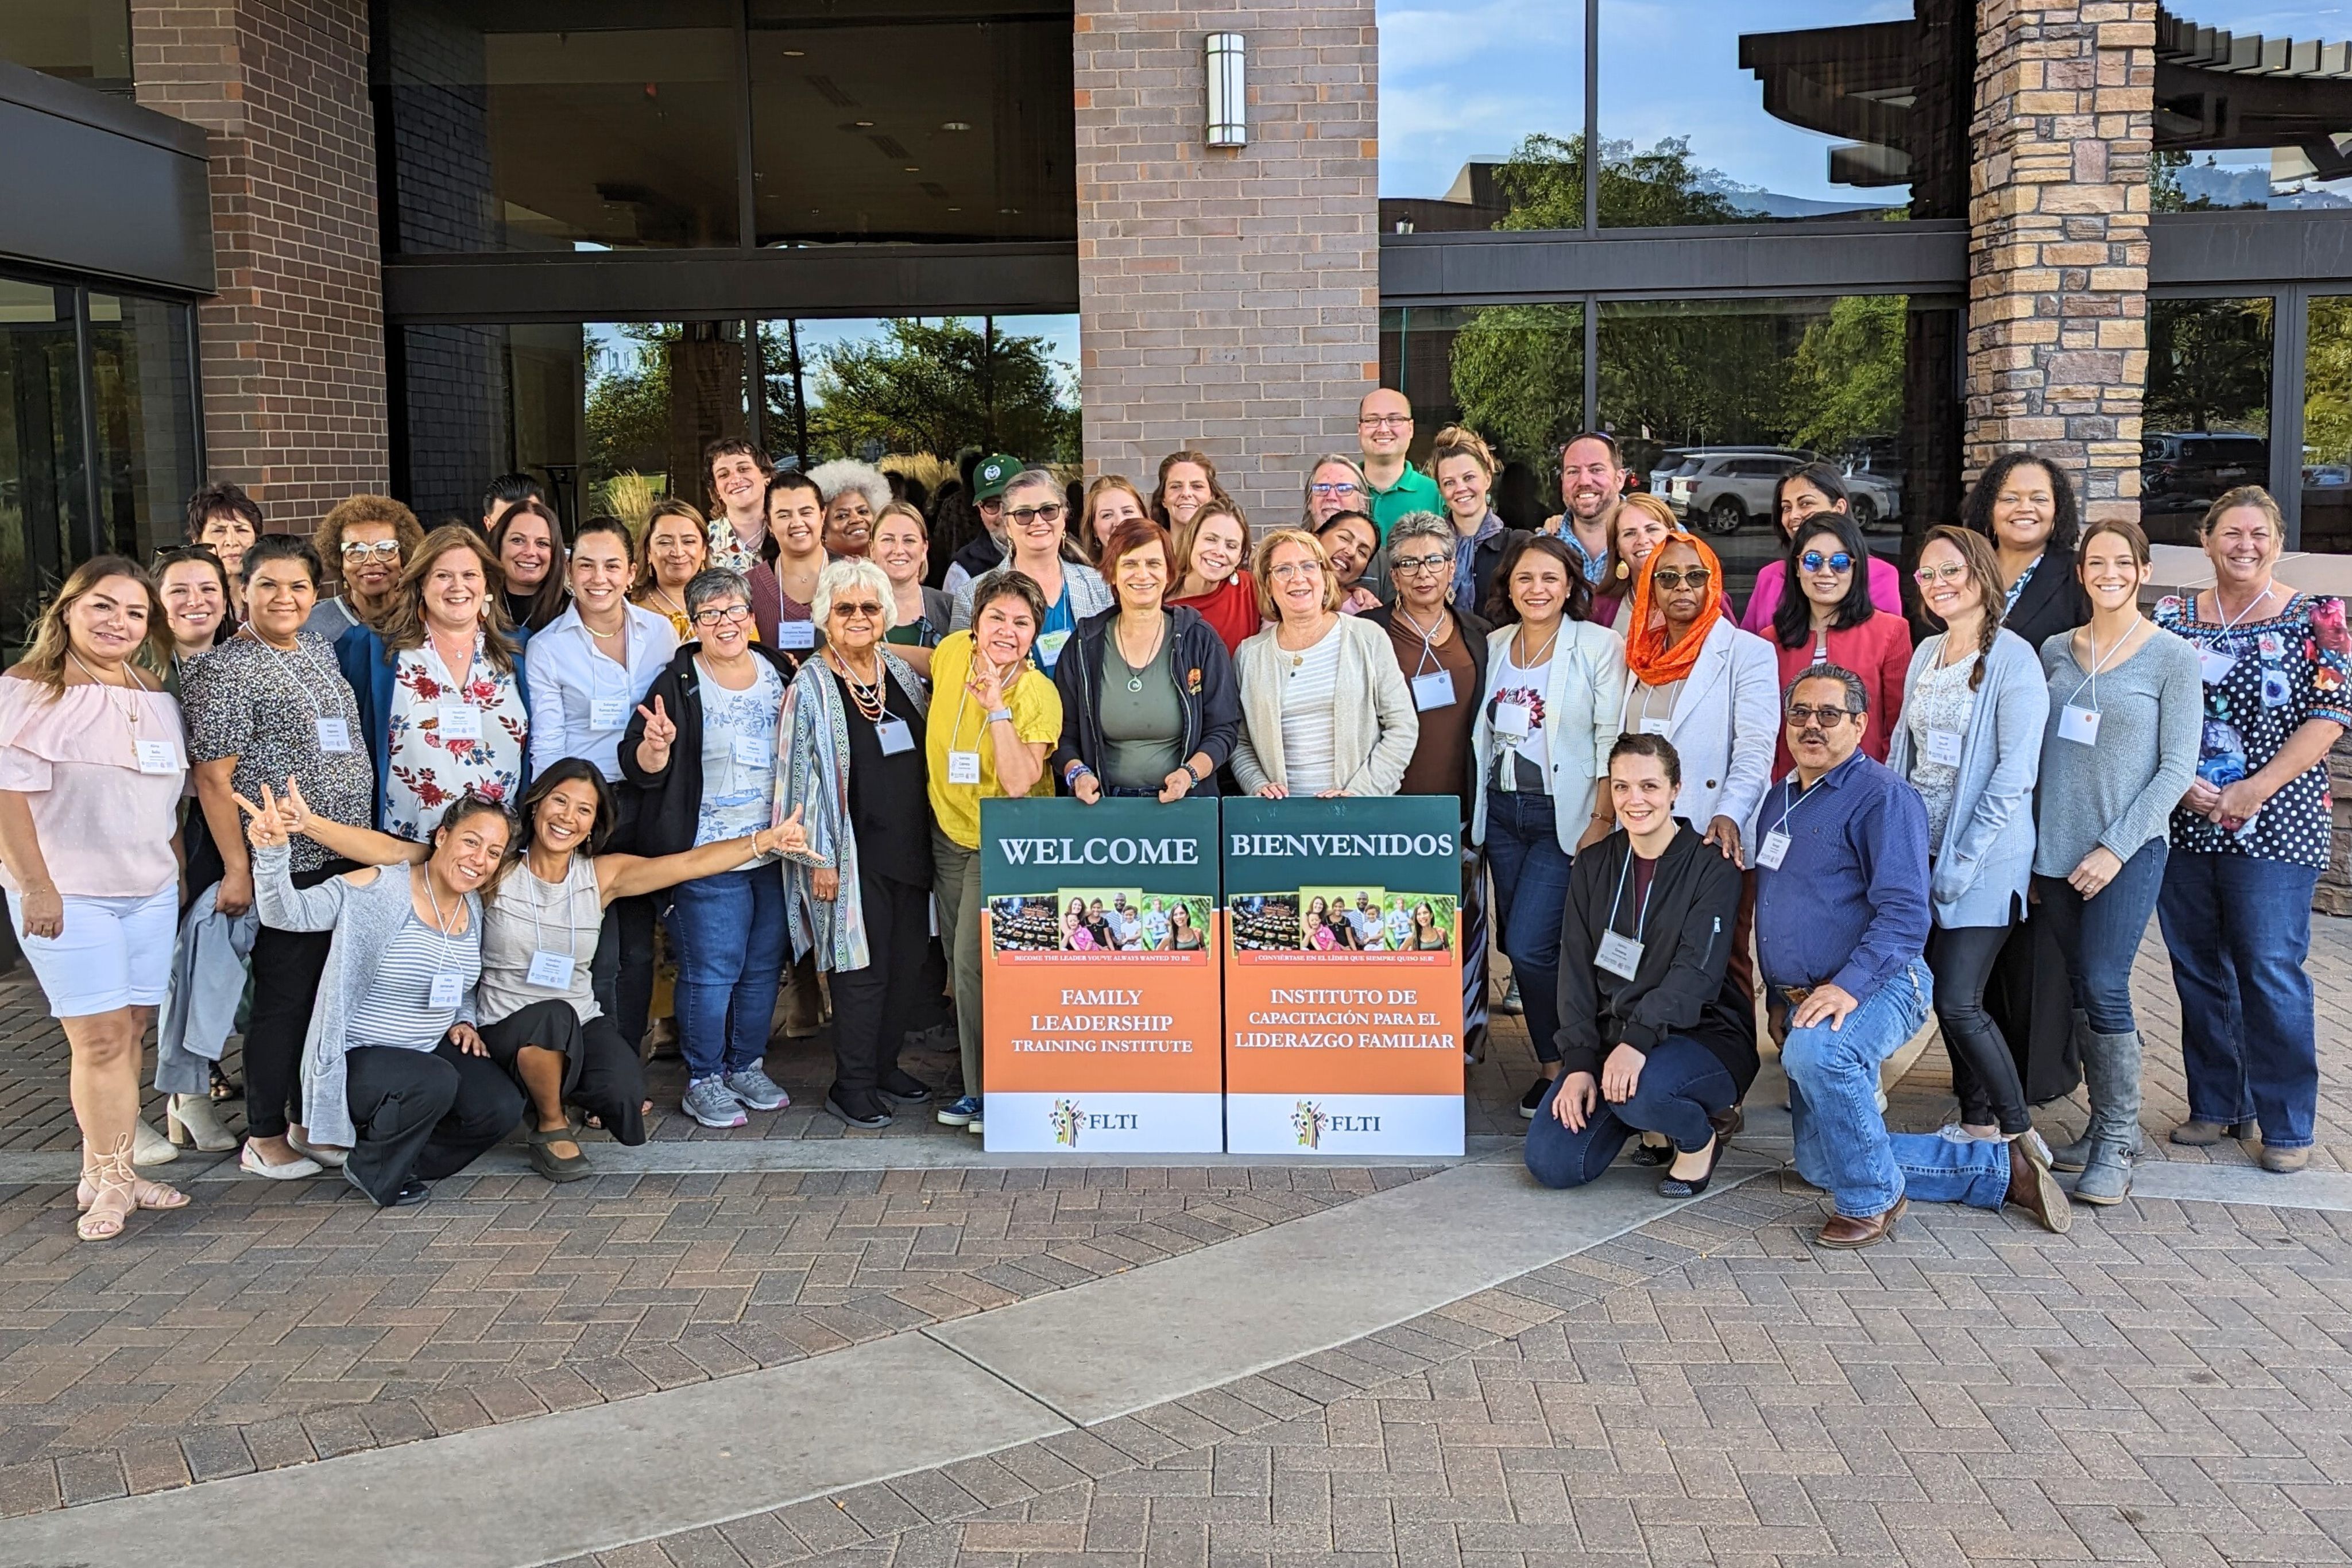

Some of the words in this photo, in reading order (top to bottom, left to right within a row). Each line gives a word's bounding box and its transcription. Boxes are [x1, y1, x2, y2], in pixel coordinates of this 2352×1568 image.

[999, 838, 1198, 865] WELCOME
[1231, 834, 1453, 857] BIENVENIDOS
[1061, 989, 1142, 1005] FAMILY
[1271, 989, 1383, 1004] INSTITUTO
[1387, 990, 1417, 1004] DE
[1031, 1016, 1173, 1031] LEADERSHIP
[1249, 1010, 1368, 1025] CAPACITACIÓN
[1374, 1013, 1414, 1025] PARA
[1418, 1013, 1440, 1025] EL
[1011, 1040, 1096, 1052] TRAINING
[1101, 1040, 1193, 1052] INSTITUTE
[1235, 1033, 1353, 1048] LIDERAZGO
[1359, 1033, 1454, 1048] FAMILIAR
[1089, 1114, 1138, 1129] FLTI
[1331, 1116, 1380, 1132] FLTI
